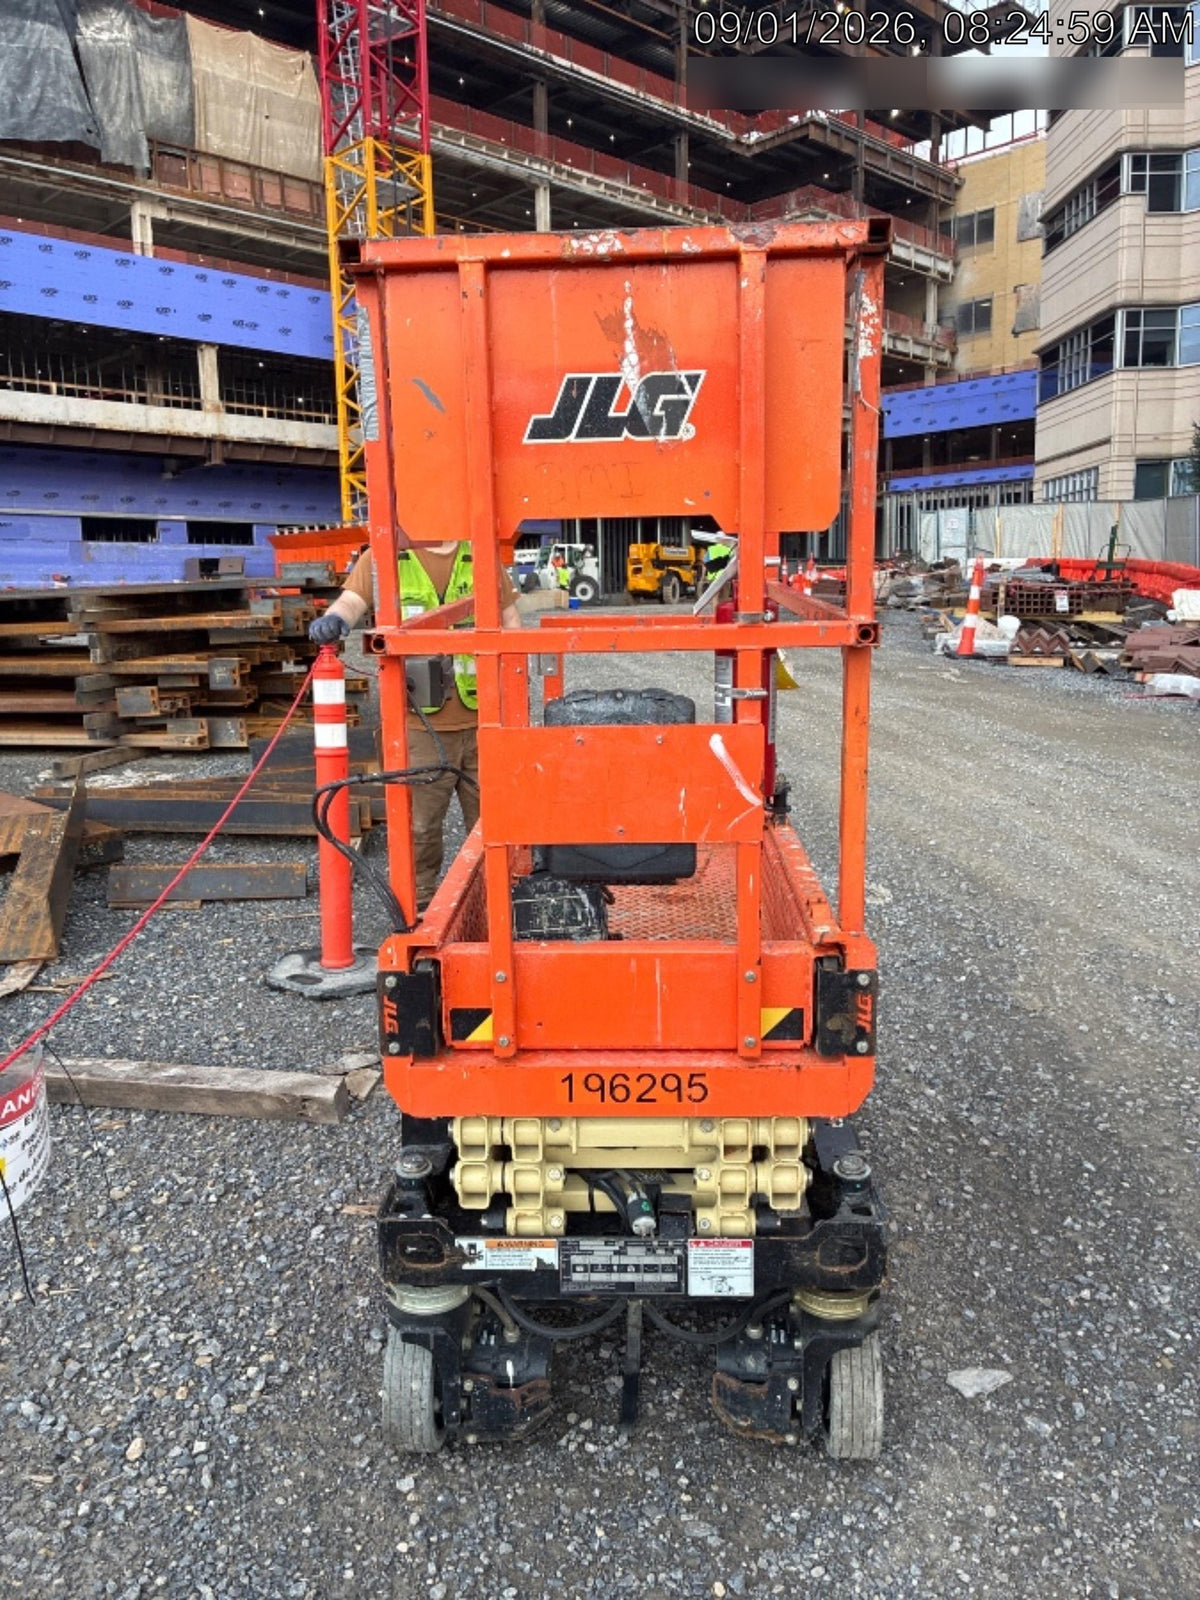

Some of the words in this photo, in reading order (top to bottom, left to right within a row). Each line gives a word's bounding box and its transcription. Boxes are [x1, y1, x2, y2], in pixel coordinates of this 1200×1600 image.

[382, 994, 399, 1034] JLG
[855, 992, 873, 1034] JLG
[560, 1072, 709, 1103] 196295
